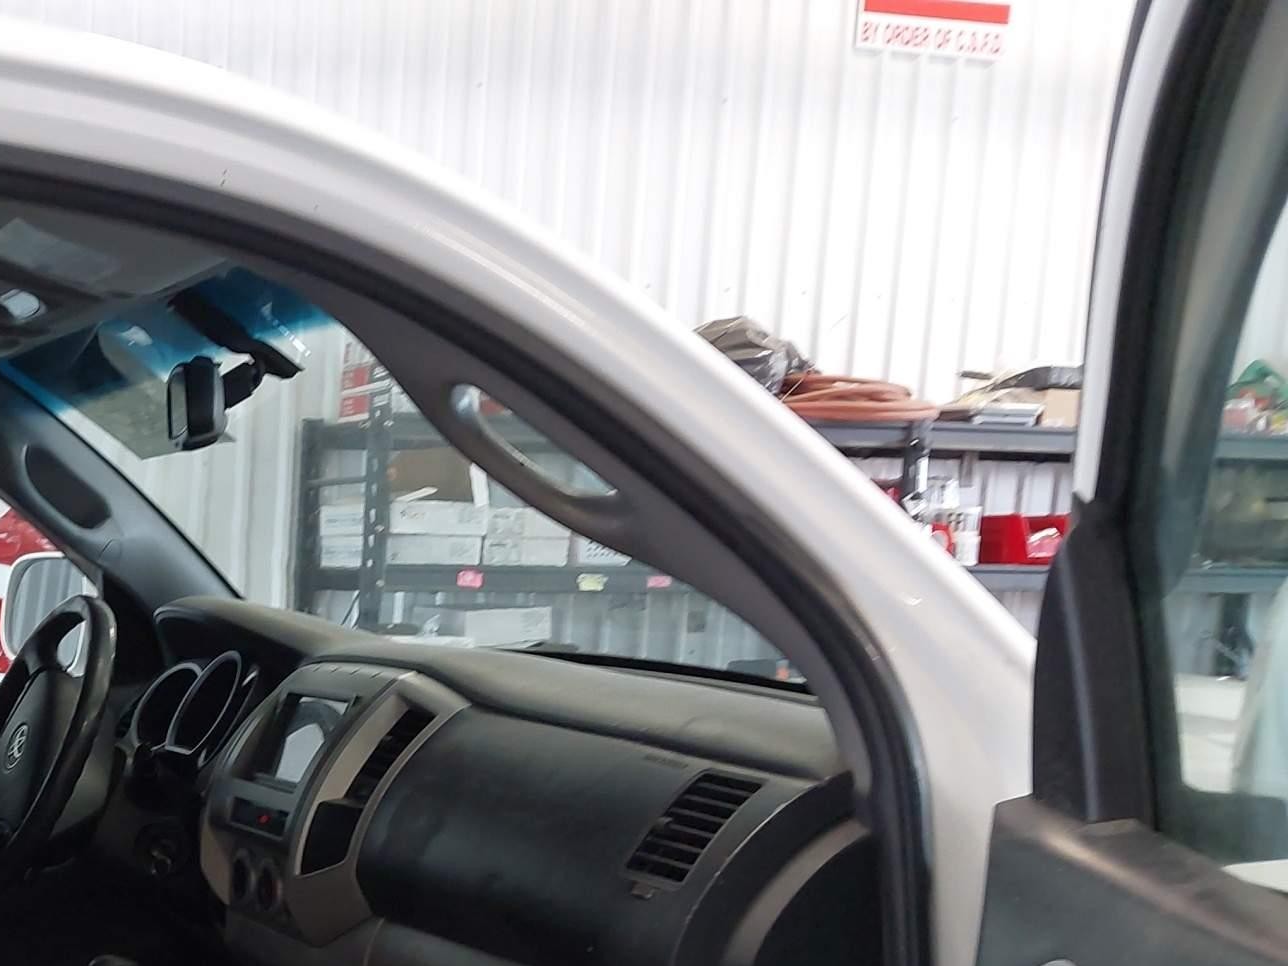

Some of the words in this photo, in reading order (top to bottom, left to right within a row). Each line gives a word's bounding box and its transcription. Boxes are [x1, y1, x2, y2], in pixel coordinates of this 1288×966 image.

[861, 20, 879, 43] BY
[883, 22, 930, 48] ORDER
[934, 27, 953, 50] OF
